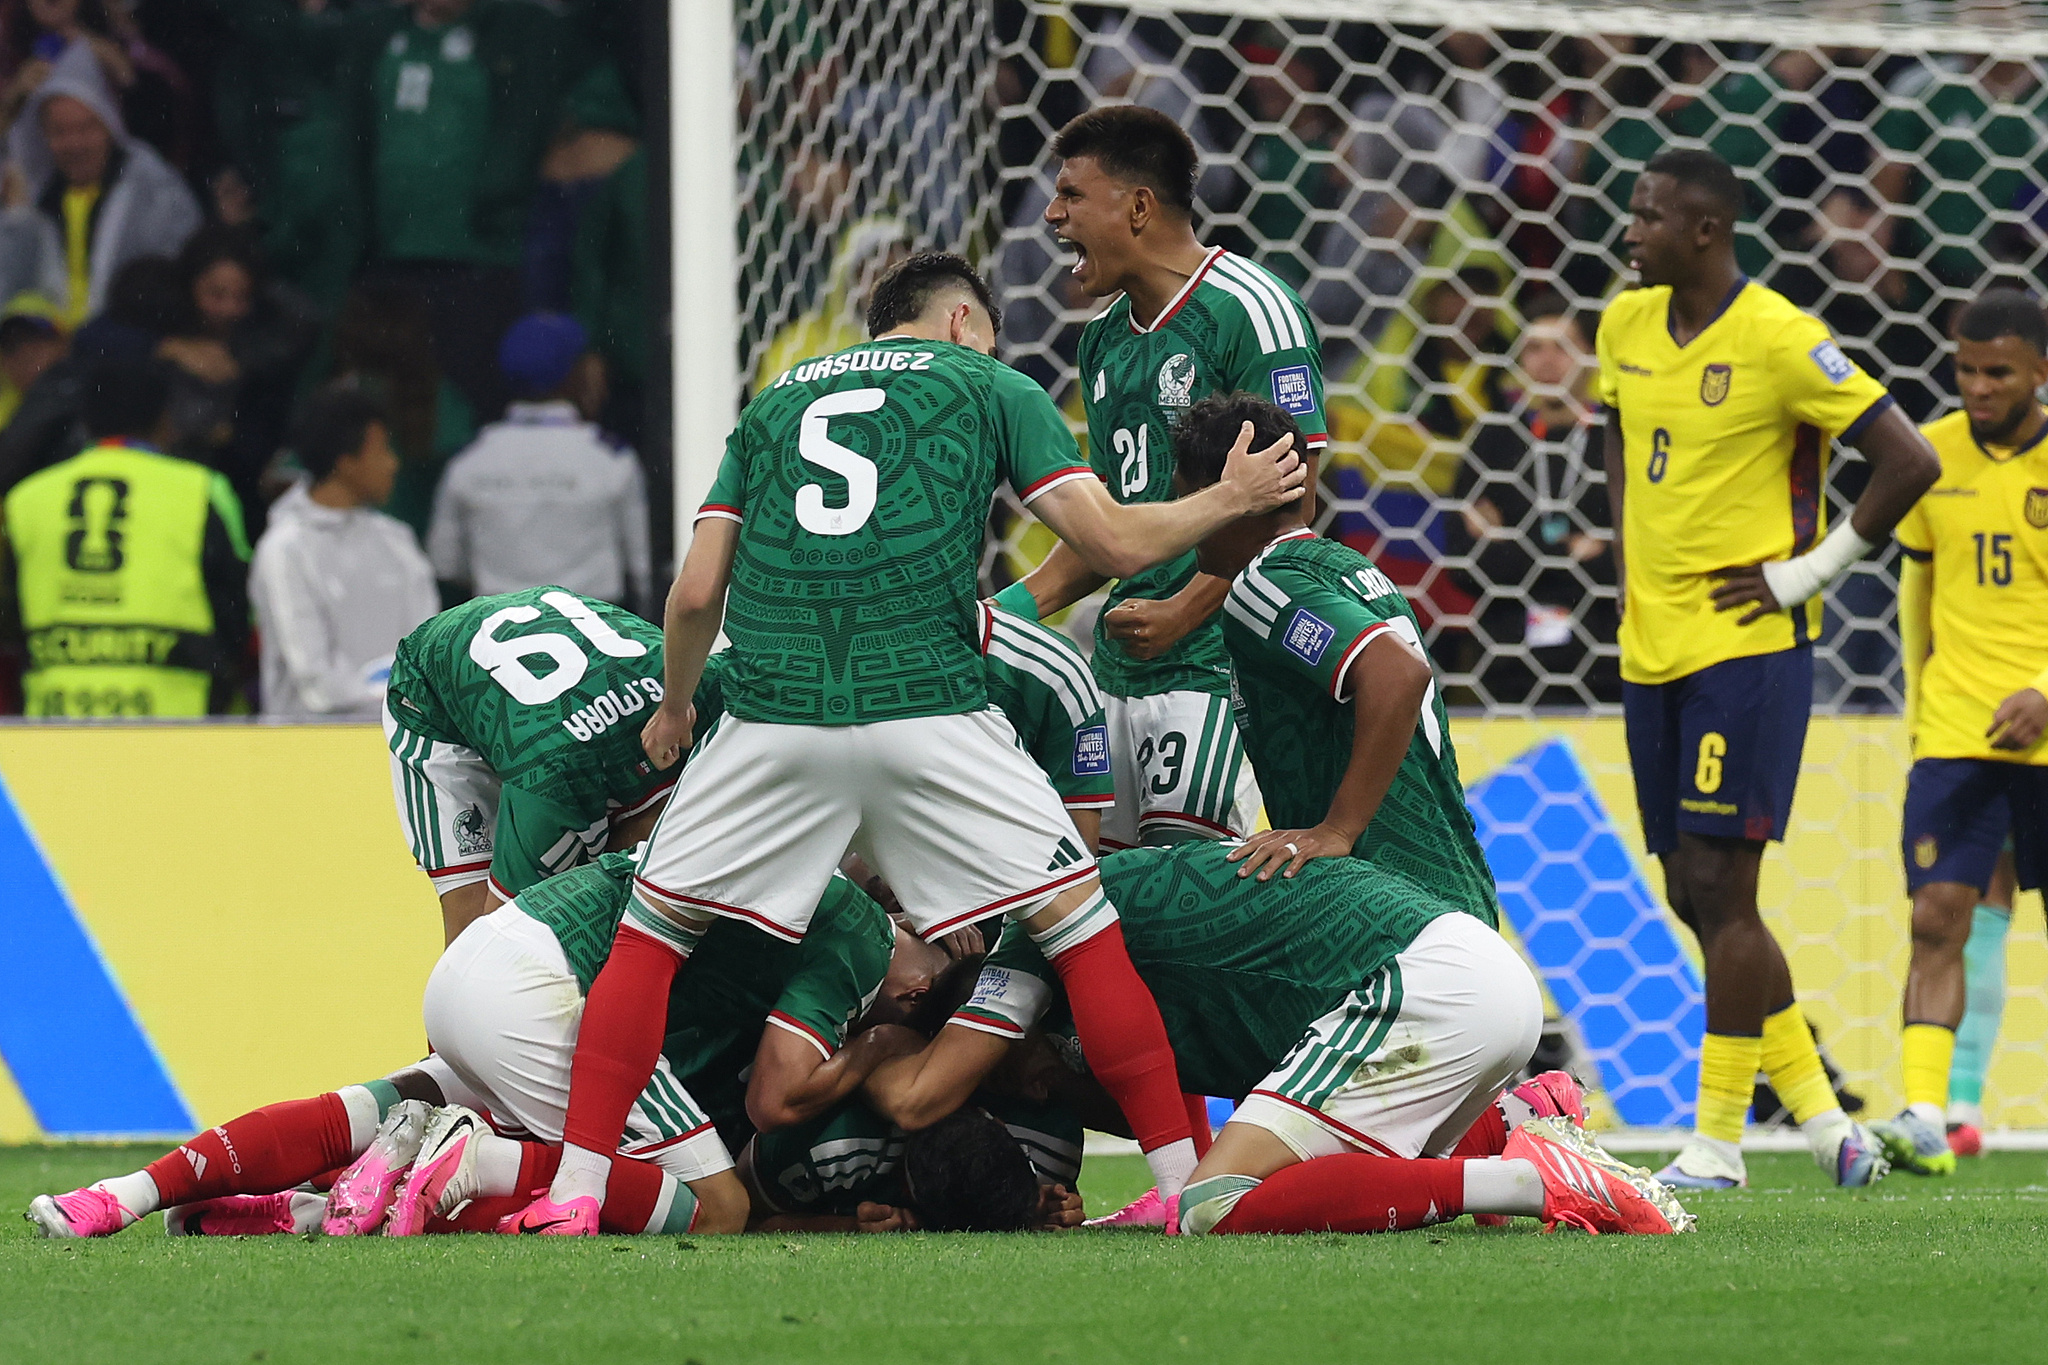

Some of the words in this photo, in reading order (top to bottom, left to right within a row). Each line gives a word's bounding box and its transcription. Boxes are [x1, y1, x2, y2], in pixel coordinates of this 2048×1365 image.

[1278, 372, 1305, 383] FOOTBALL
[1279, 381, 1307, 394] UNITES
[795, 388, 886, 535] 5
[1648, 427, 1671, 484] 6
[1972, 533, 2013, 587] 15
[1289, 618, 1308, 645] FOOTBALL
[1295, 621, 1315, 650] UNITES
[469, 591, 647, 705] 19
[562, 677, 664, 742] G.MORA
[1079, 741, 1104, 752] UNITES
[1088, 751, 1105, 761] World
[1694, 731, 1727, 794] 6
[977, 978, 1008, 987] NITES
